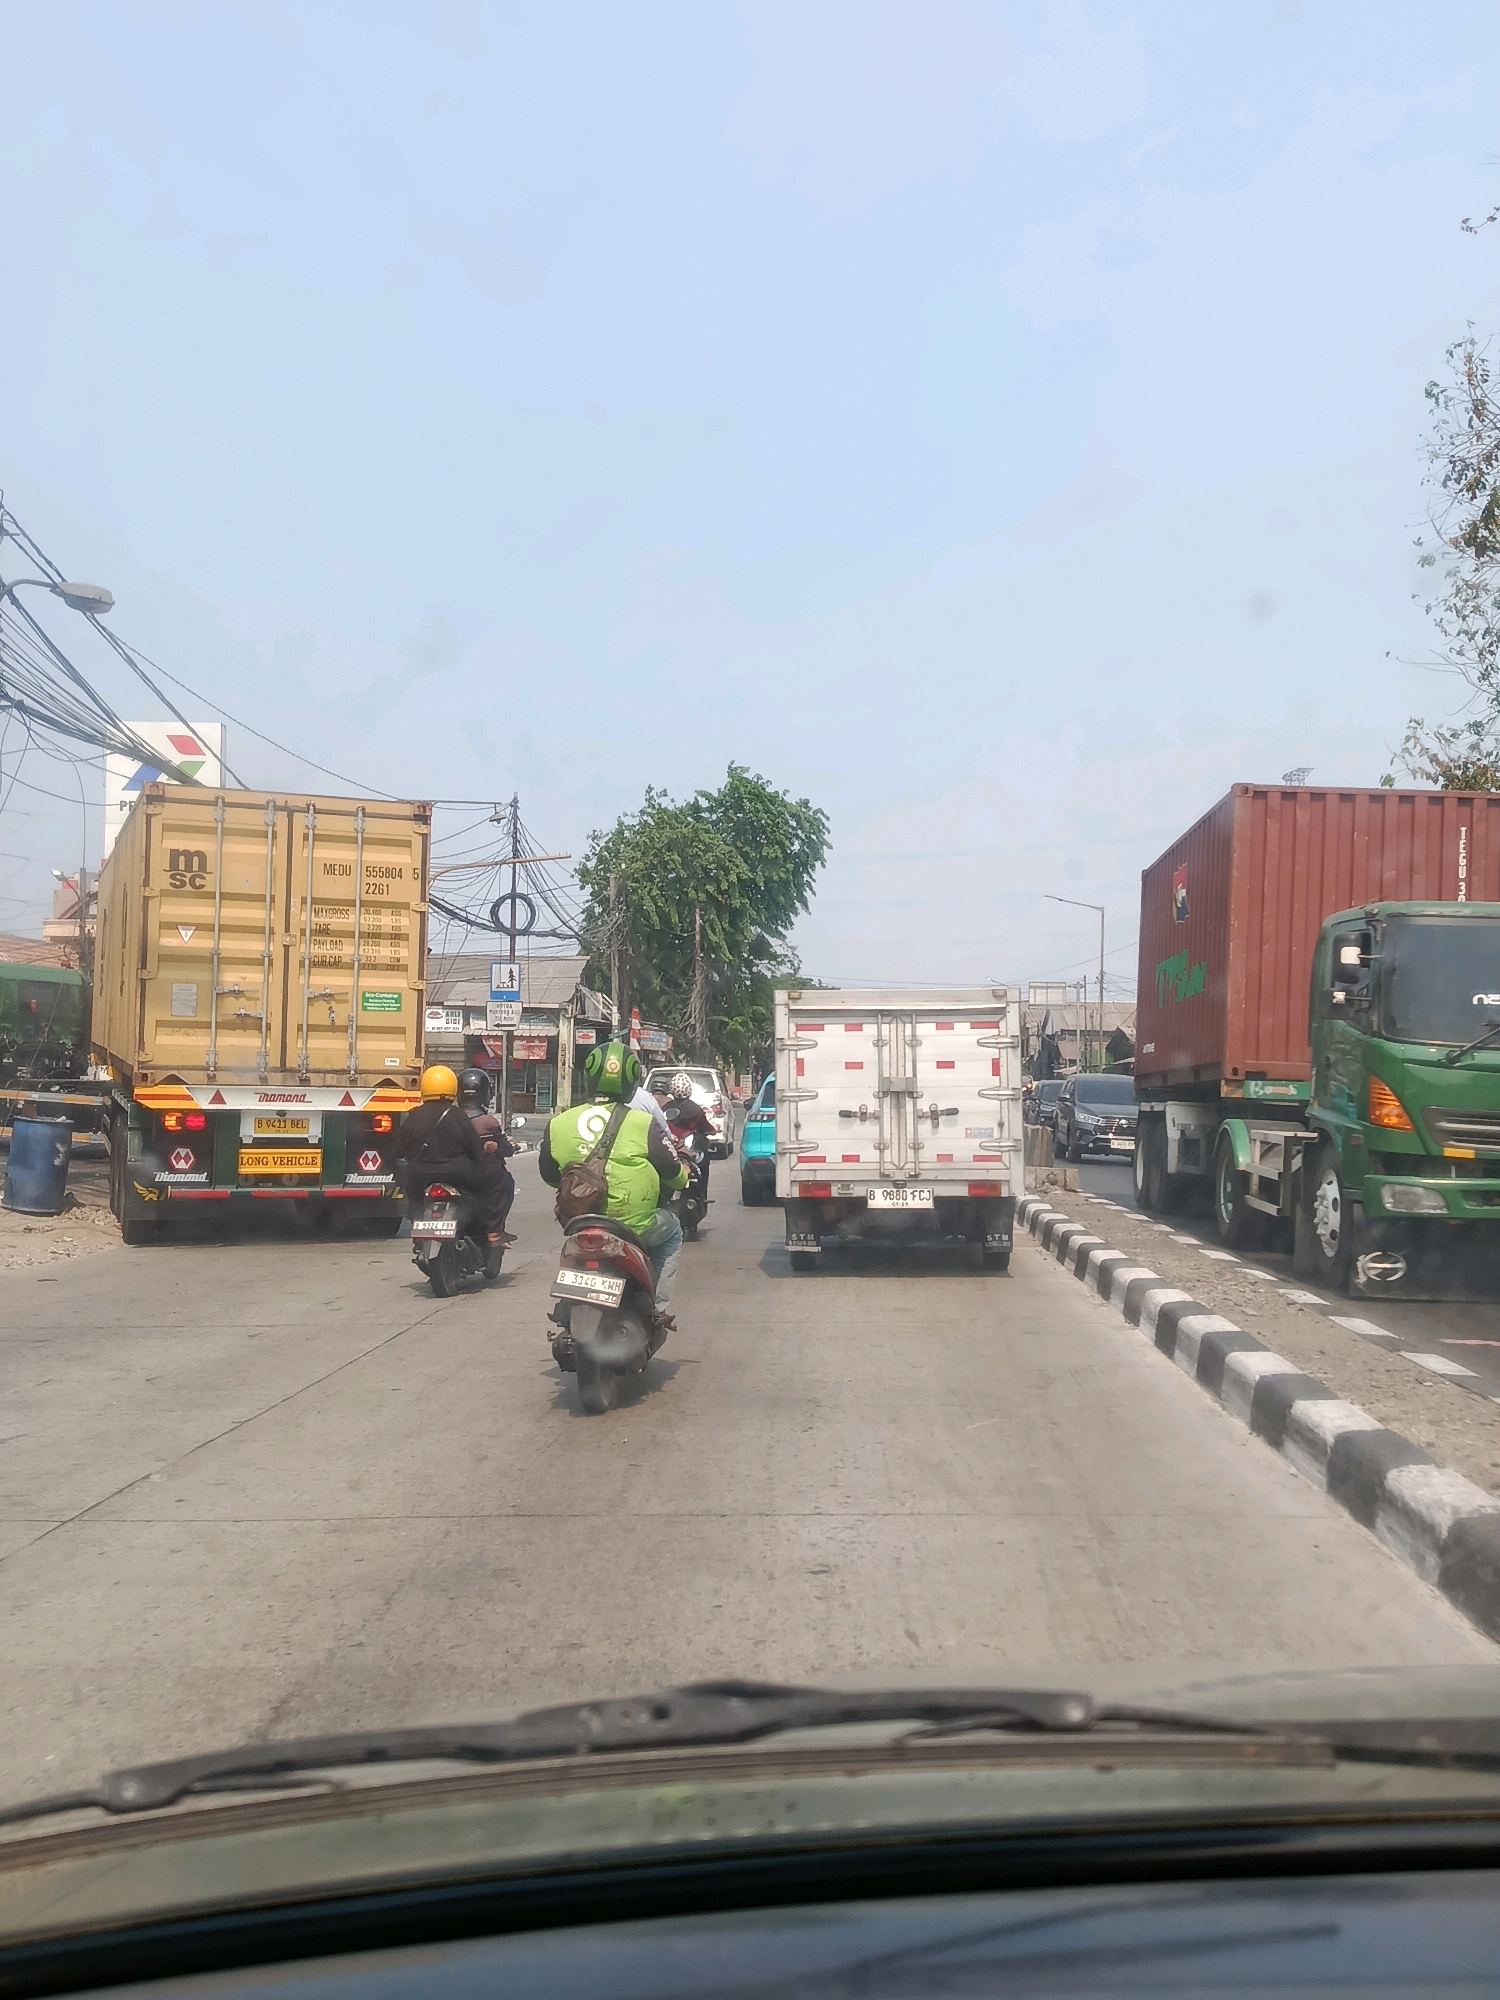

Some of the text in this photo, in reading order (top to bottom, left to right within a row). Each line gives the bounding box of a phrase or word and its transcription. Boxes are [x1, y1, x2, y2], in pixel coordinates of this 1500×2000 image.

[1458, 827, 1467, 878] TEGU
[323, 863, 419, 880] MEDU 555804 5
[365, 882, 390, 896] 22G1
[314, 923, 331, 936] TARE
[313, 939, 344, 952] PAYLOAD
[258, 1120, 263, 1128] B
[291, 1120, 306, 1128] BEL
[240, 1156, 318, 1166] LONG VEHICLE
[153, 1171, 209, 1182] Diamond
[345, 1173, 396, 1183] Diamond
[869, 1190, 875, 1200] B
[560, 1272, 566, 1282] B
